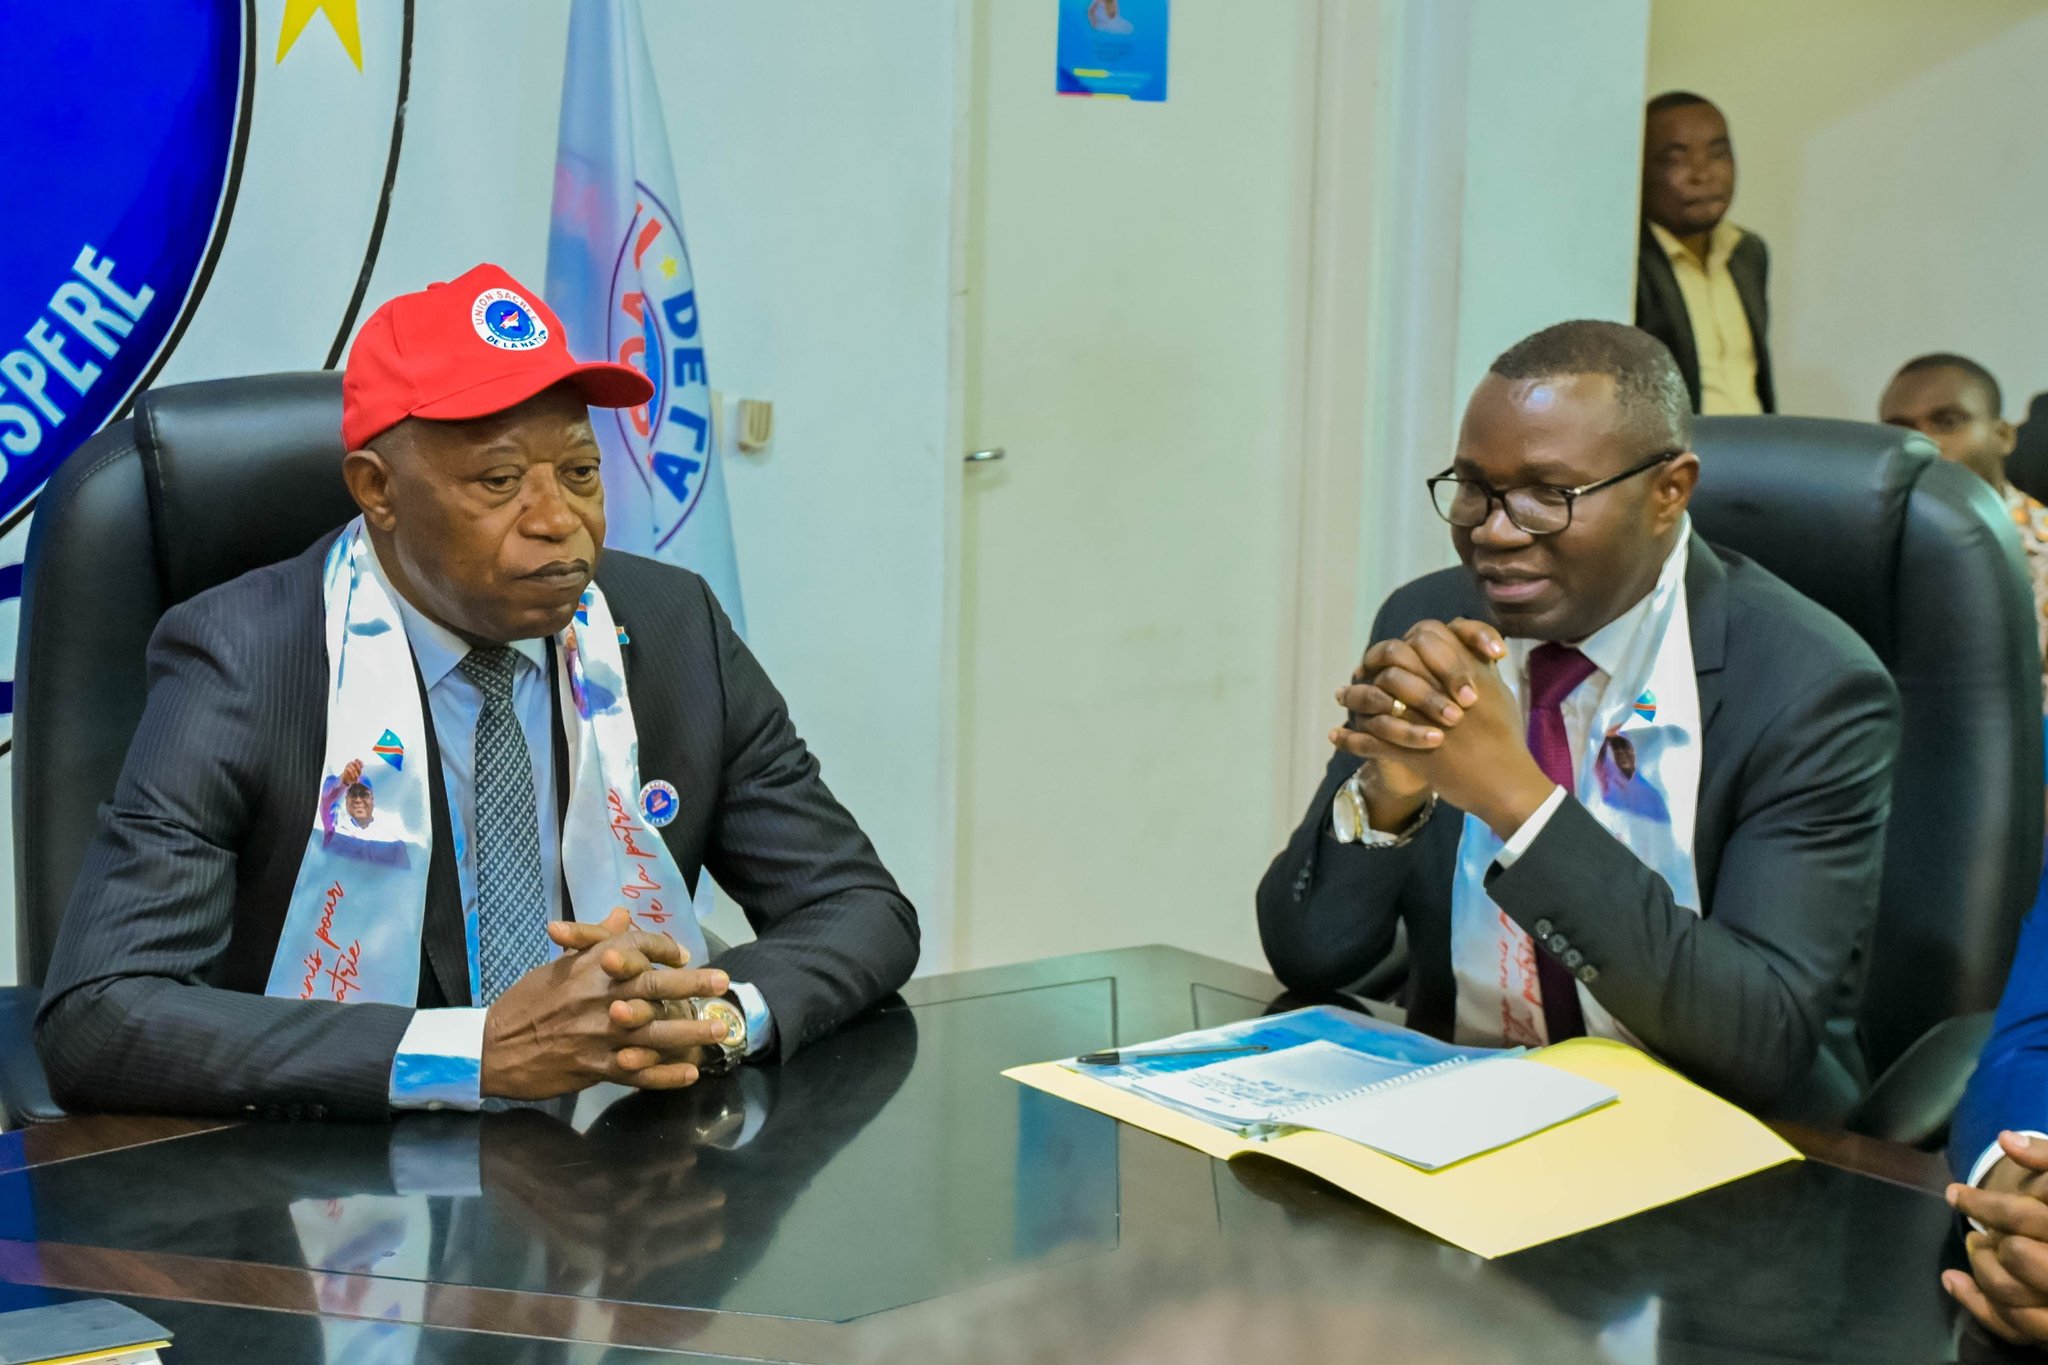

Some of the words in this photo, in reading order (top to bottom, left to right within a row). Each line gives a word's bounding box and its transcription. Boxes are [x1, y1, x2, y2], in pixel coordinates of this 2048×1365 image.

[475, 292, 494, 326] UNION
[0, 243, 155, 484] SPERE
[487, 335, 499, 346] DE
[315, 880, 345, 950] pour
[637, 898, 673, 924] de
[325, 939, 361, 1002] atrie
